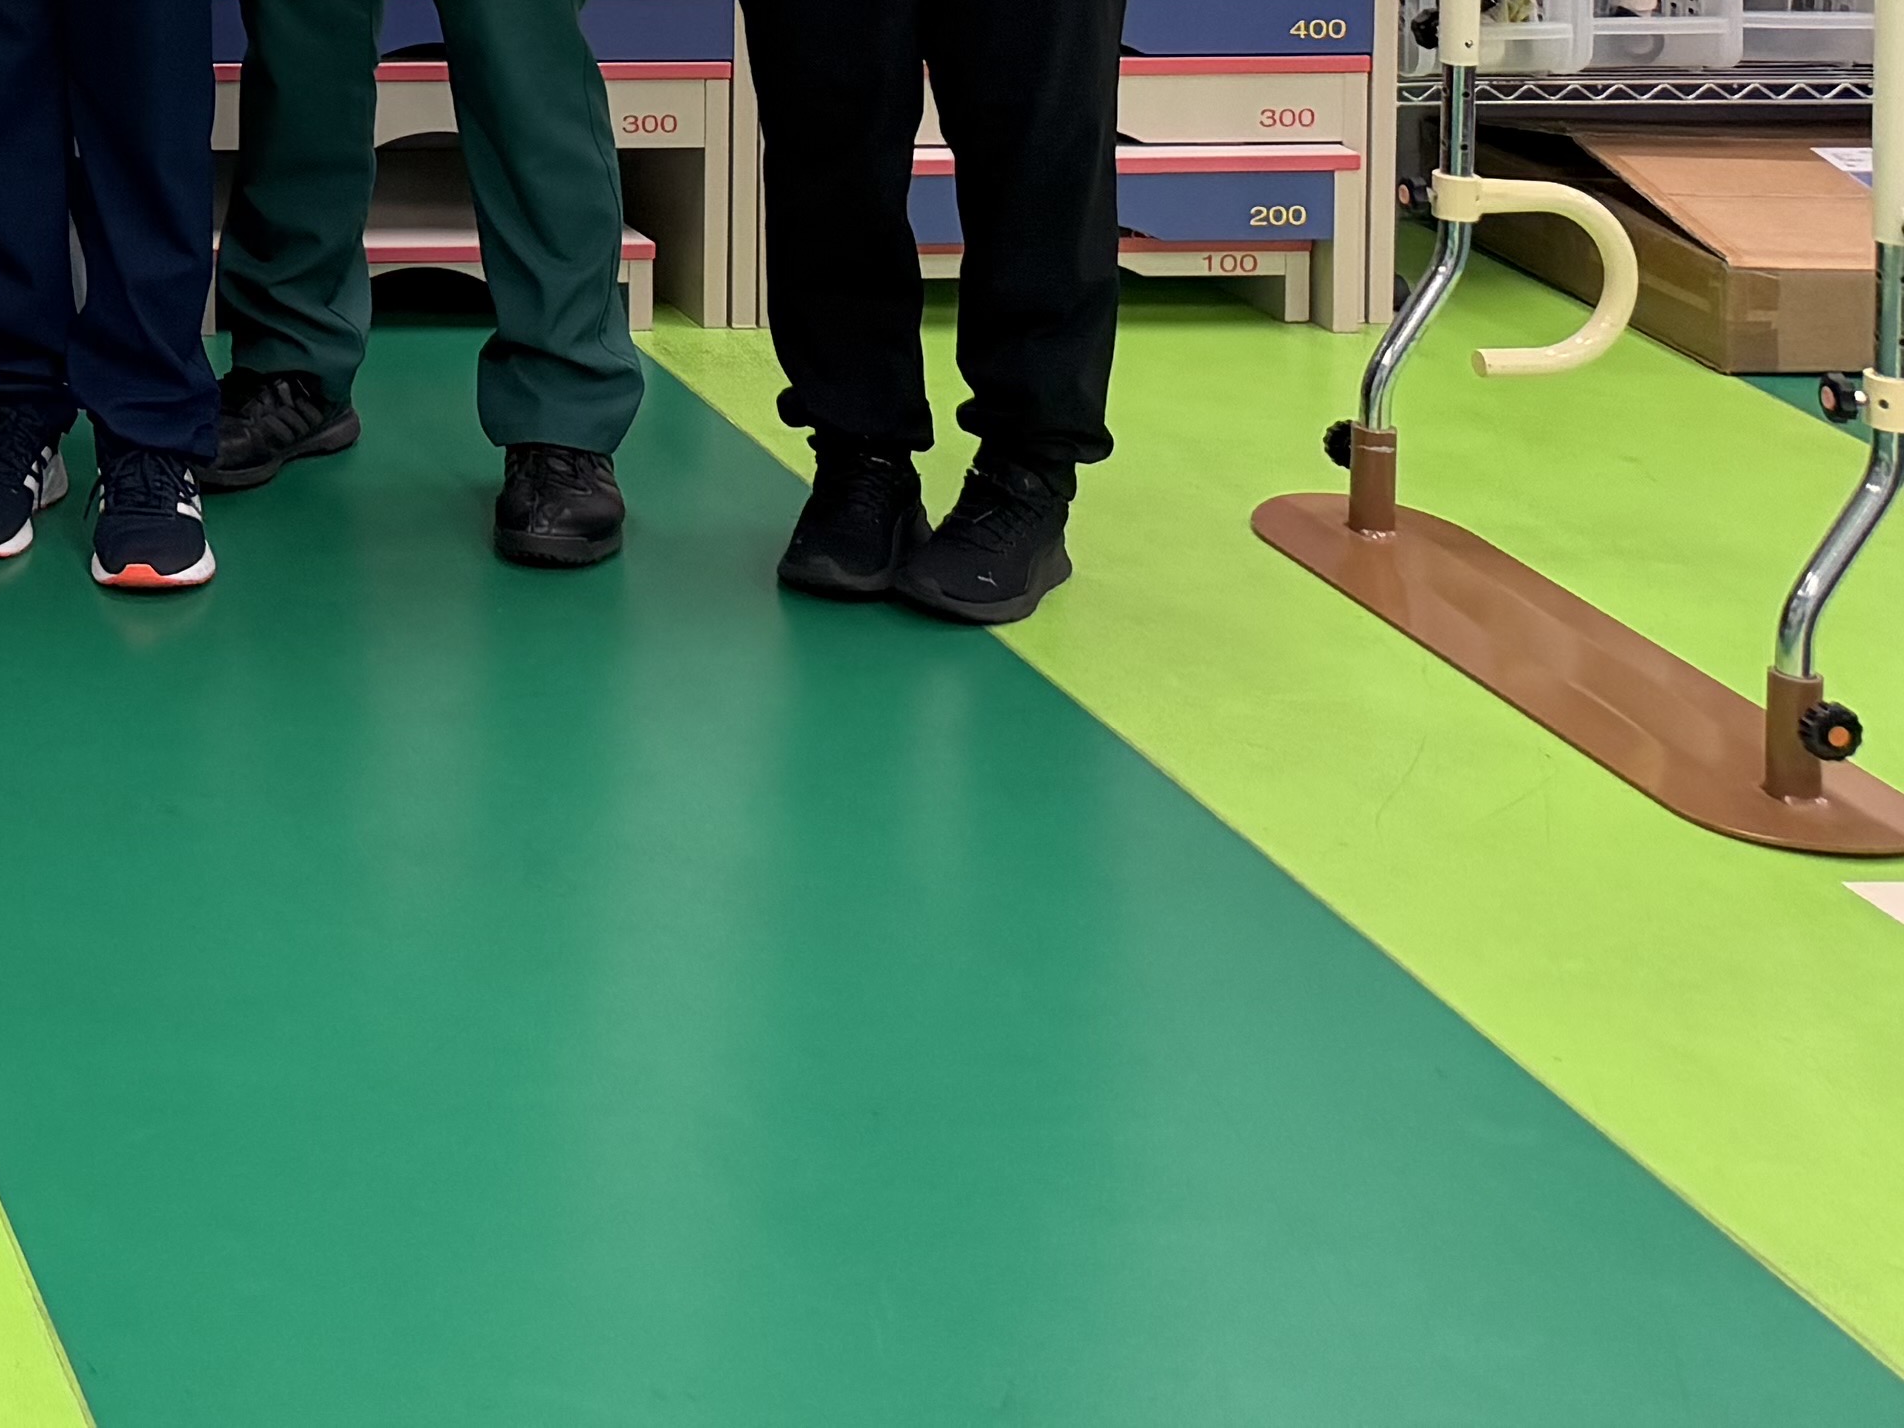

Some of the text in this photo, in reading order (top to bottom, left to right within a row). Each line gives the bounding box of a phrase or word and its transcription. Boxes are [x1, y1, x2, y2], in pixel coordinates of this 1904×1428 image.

[1290, 18, 1347, 40] 400
[621, 114, 679, 134] 300
[1258, 107, 1315, 129] 300
[1247, 205, 1308, 227] 200
[1200, 253, 1259, 274] 100
